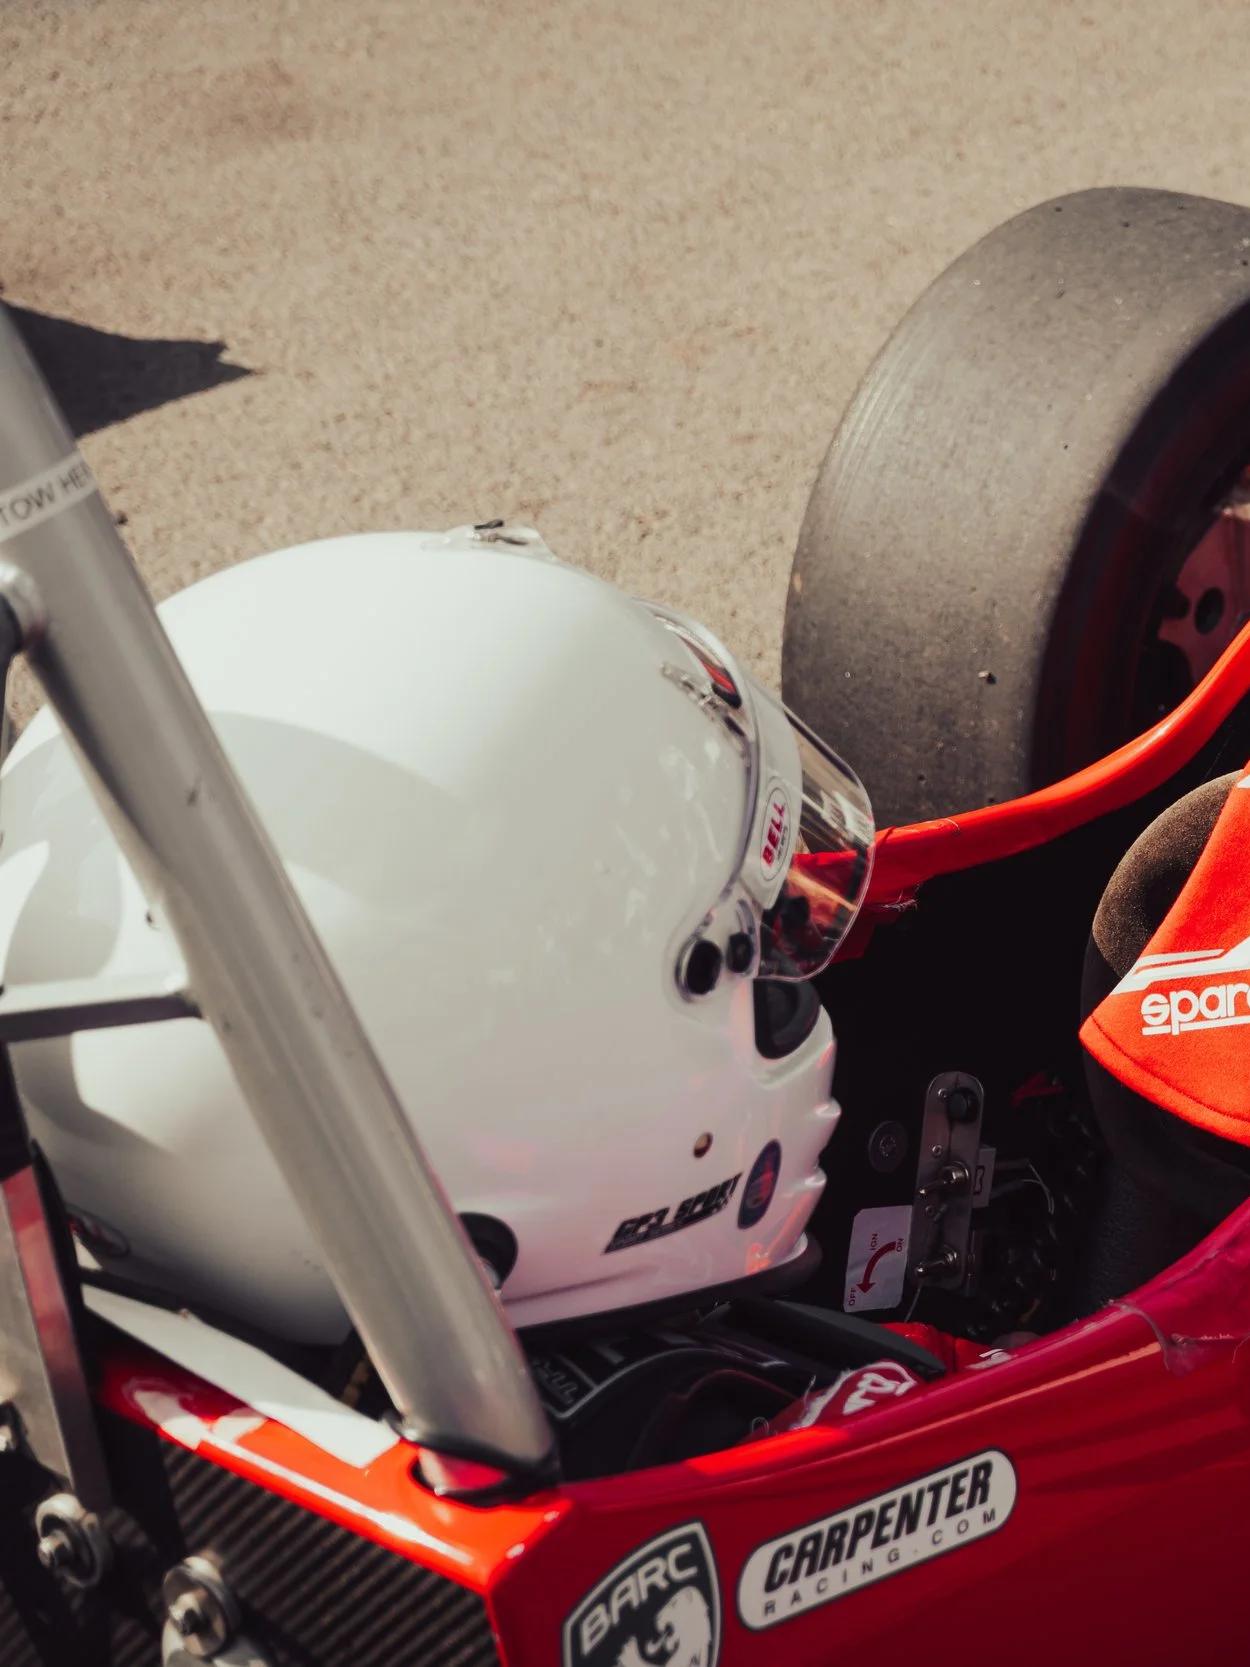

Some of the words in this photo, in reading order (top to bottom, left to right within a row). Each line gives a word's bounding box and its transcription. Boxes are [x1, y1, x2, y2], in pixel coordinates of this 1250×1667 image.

[0, 483, 55, 526] TOW
[762, 802, 785, 867] BELL
[870, 1233, 878, 1251] IGN
[896, 1238, 904, 1252] ON
[849, 1287, 857, 1306] OFF
[763, 1459, 993, 1593] CARPENTER
[580, 1542, 699, 1658] BARC
